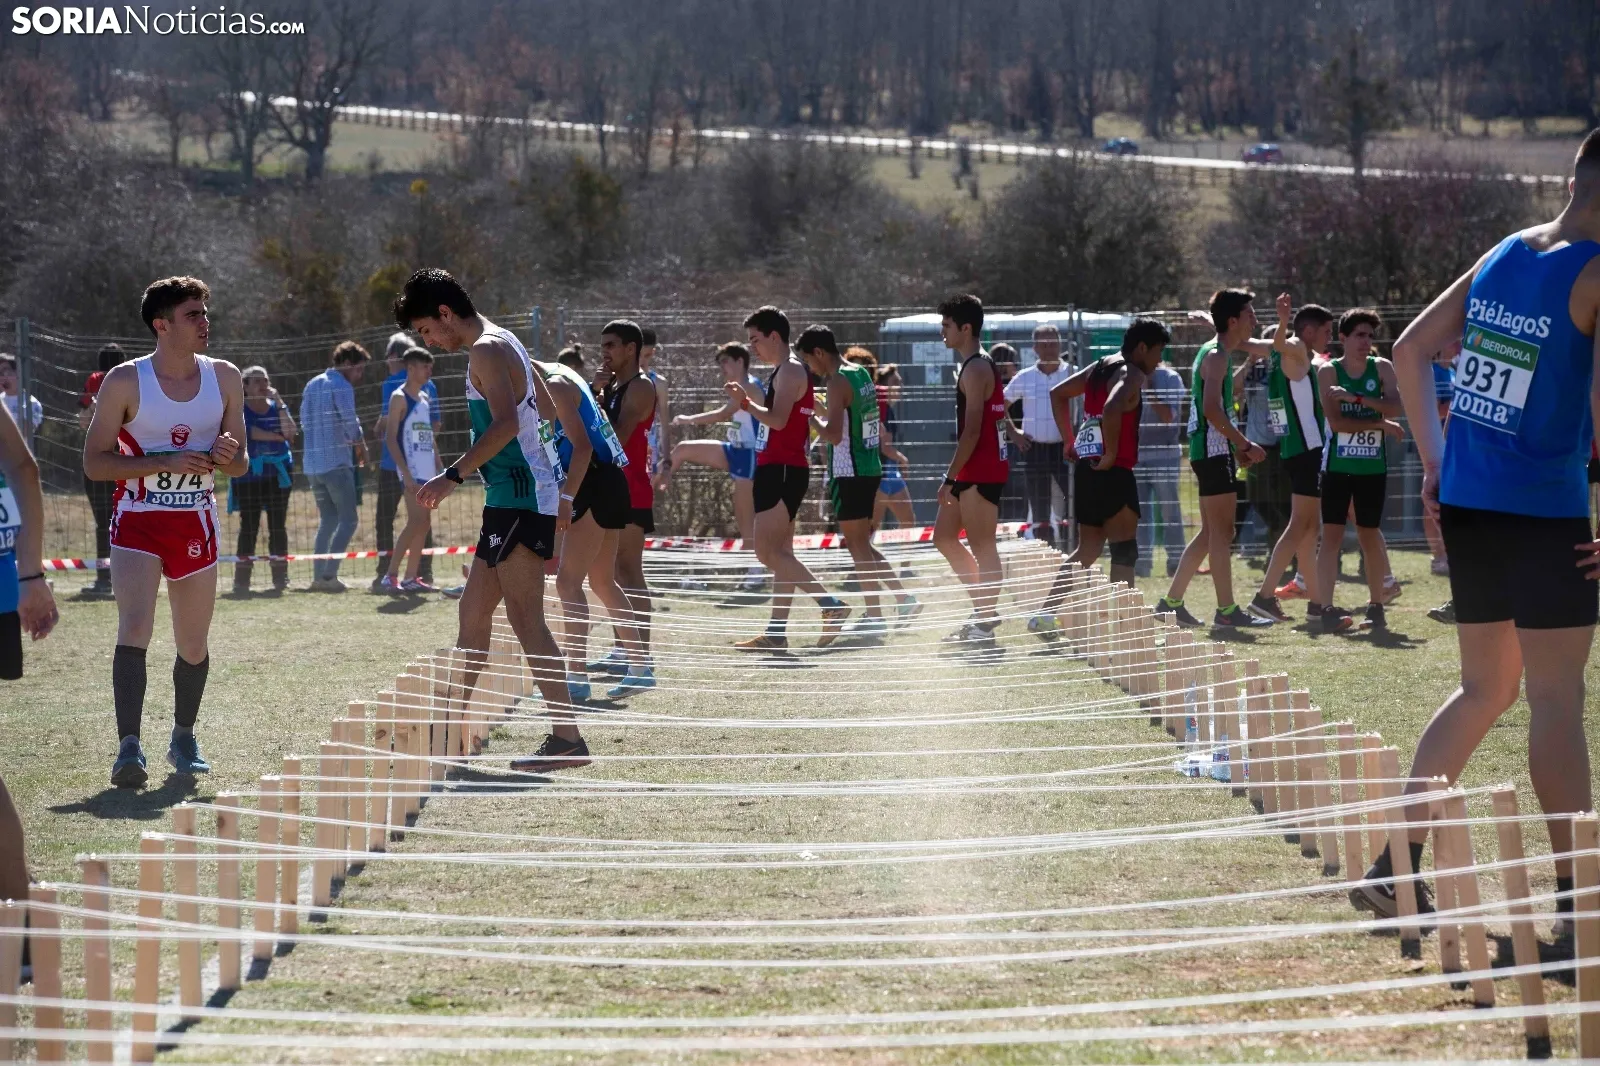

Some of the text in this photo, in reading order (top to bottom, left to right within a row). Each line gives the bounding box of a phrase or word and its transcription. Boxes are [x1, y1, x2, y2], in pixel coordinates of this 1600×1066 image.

[1481, 339, 1531, 363] IBERDROLA
[1461, 356, 1513, 399] 931
[1348, 430, 1376, 446] 786
[157, 471, 202, 490] 874
